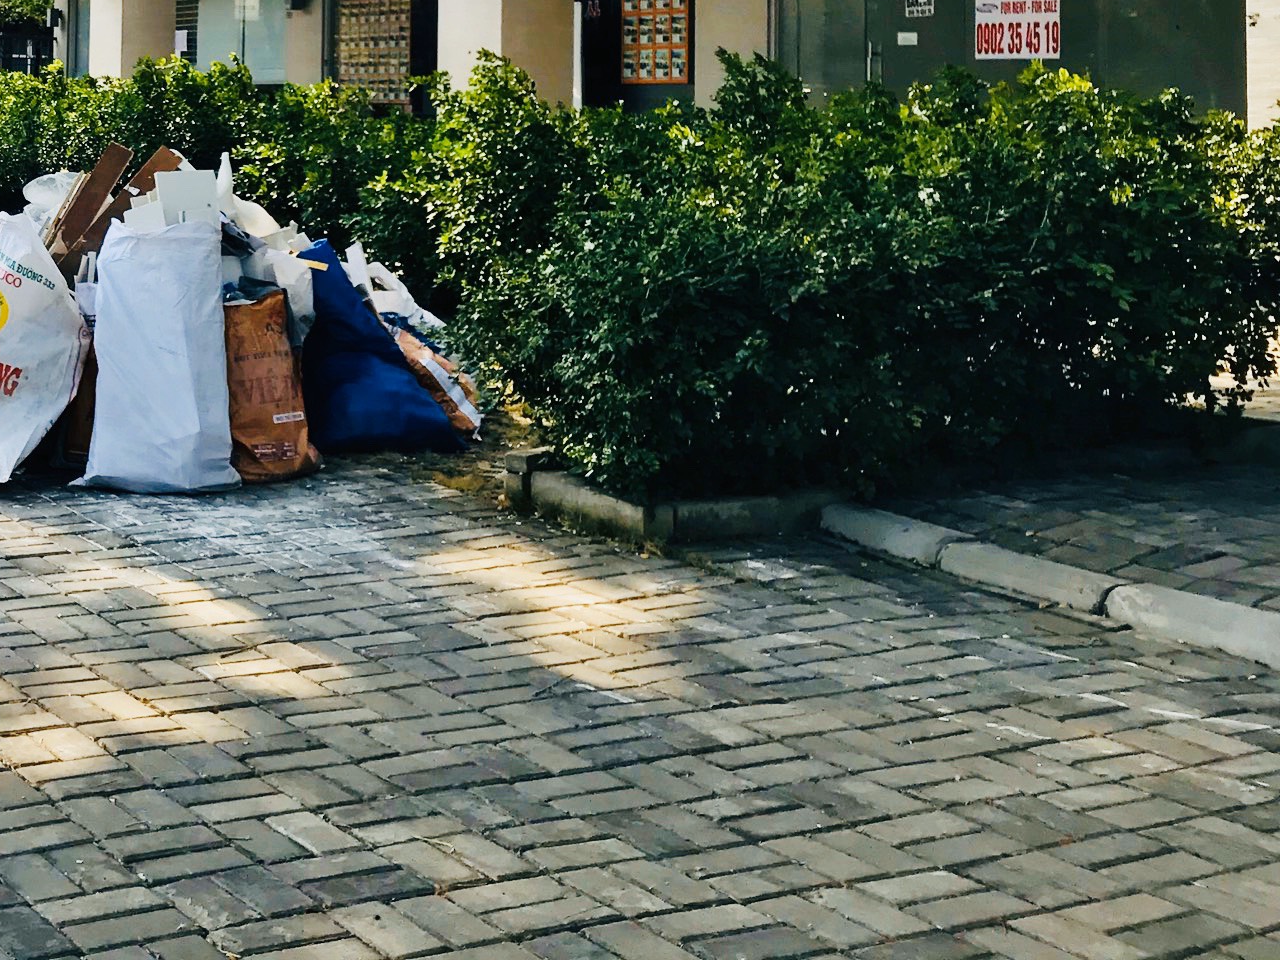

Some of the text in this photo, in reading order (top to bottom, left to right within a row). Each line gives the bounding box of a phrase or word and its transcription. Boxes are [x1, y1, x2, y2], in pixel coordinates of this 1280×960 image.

[1001, 1, 1012, 15] FOR
[1031, 0, 1043, 14] FOR
[1044, 0, 1058, 14] SALE
[976, 21, 1059, 55] 0902 35 45 19
